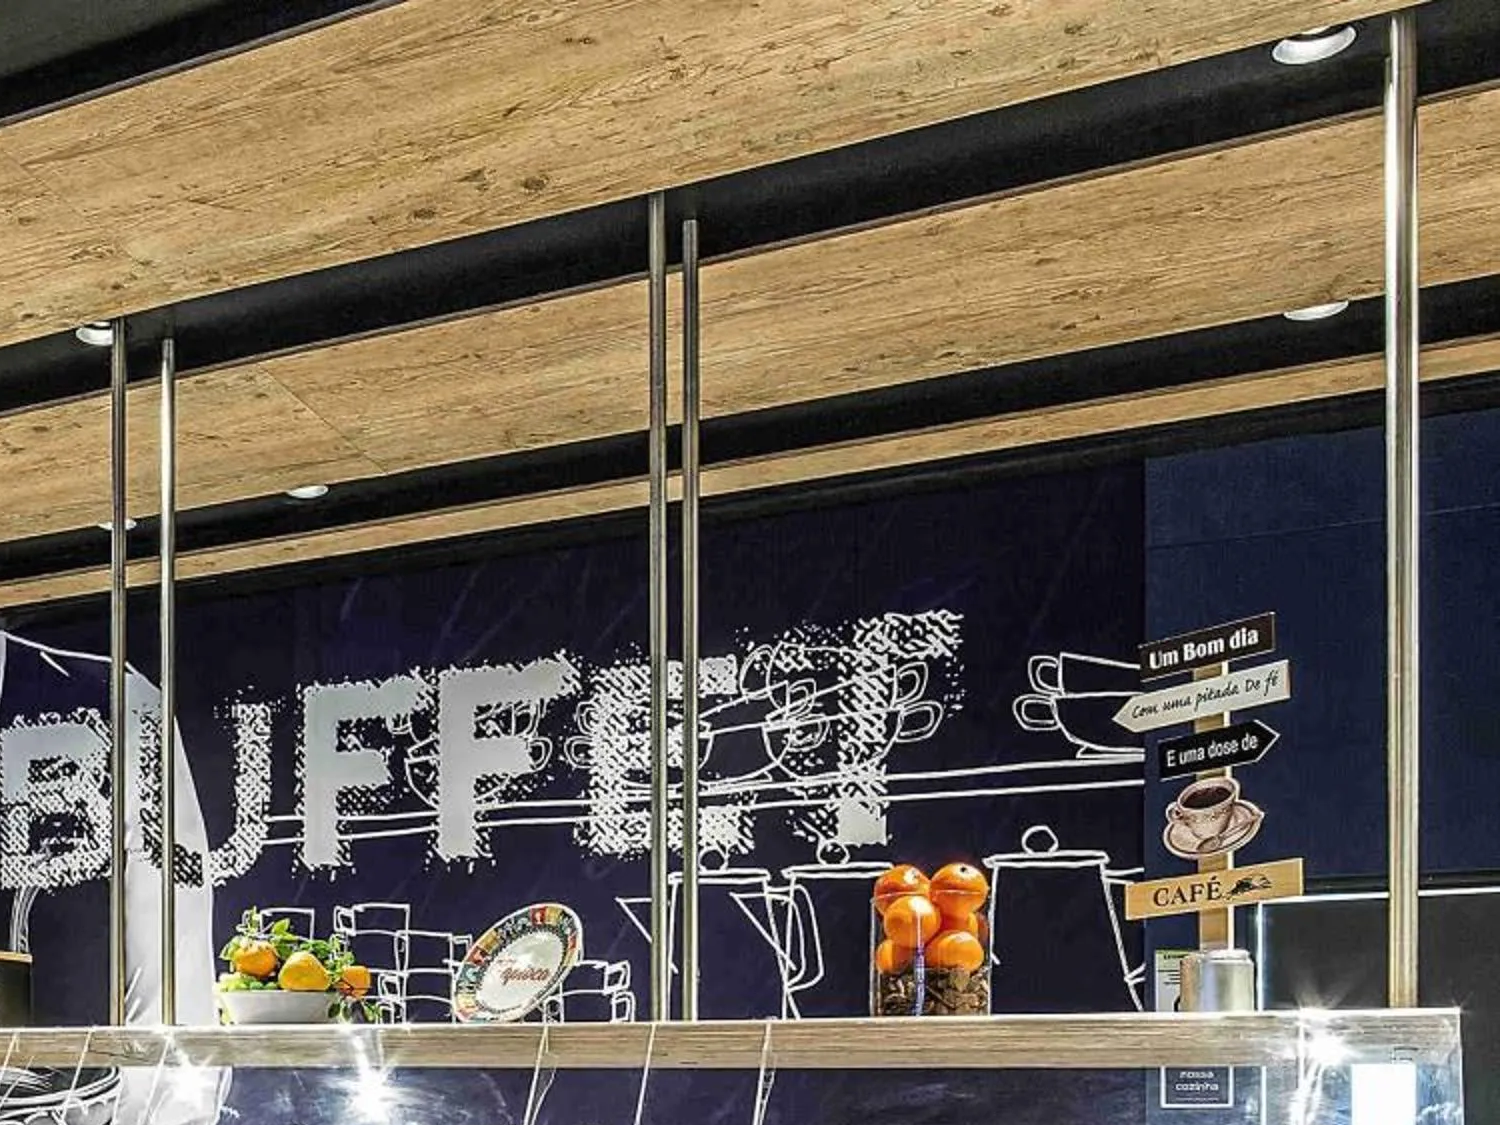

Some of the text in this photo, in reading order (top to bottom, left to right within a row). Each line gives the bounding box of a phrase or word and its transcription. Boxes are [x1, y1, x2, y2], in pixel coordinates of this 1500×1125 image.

[1149, 627, 1259, 669] Um Bom dia
[1162, 695, 1192, 711] uma
[1194, 680, 1240, 712] pitada
[1167, 732, 1259, 767] E uma dose de
[1153, 874, 1224, 907] CAFÉ
[1175, 1081, 1219, 1091] cozinha
